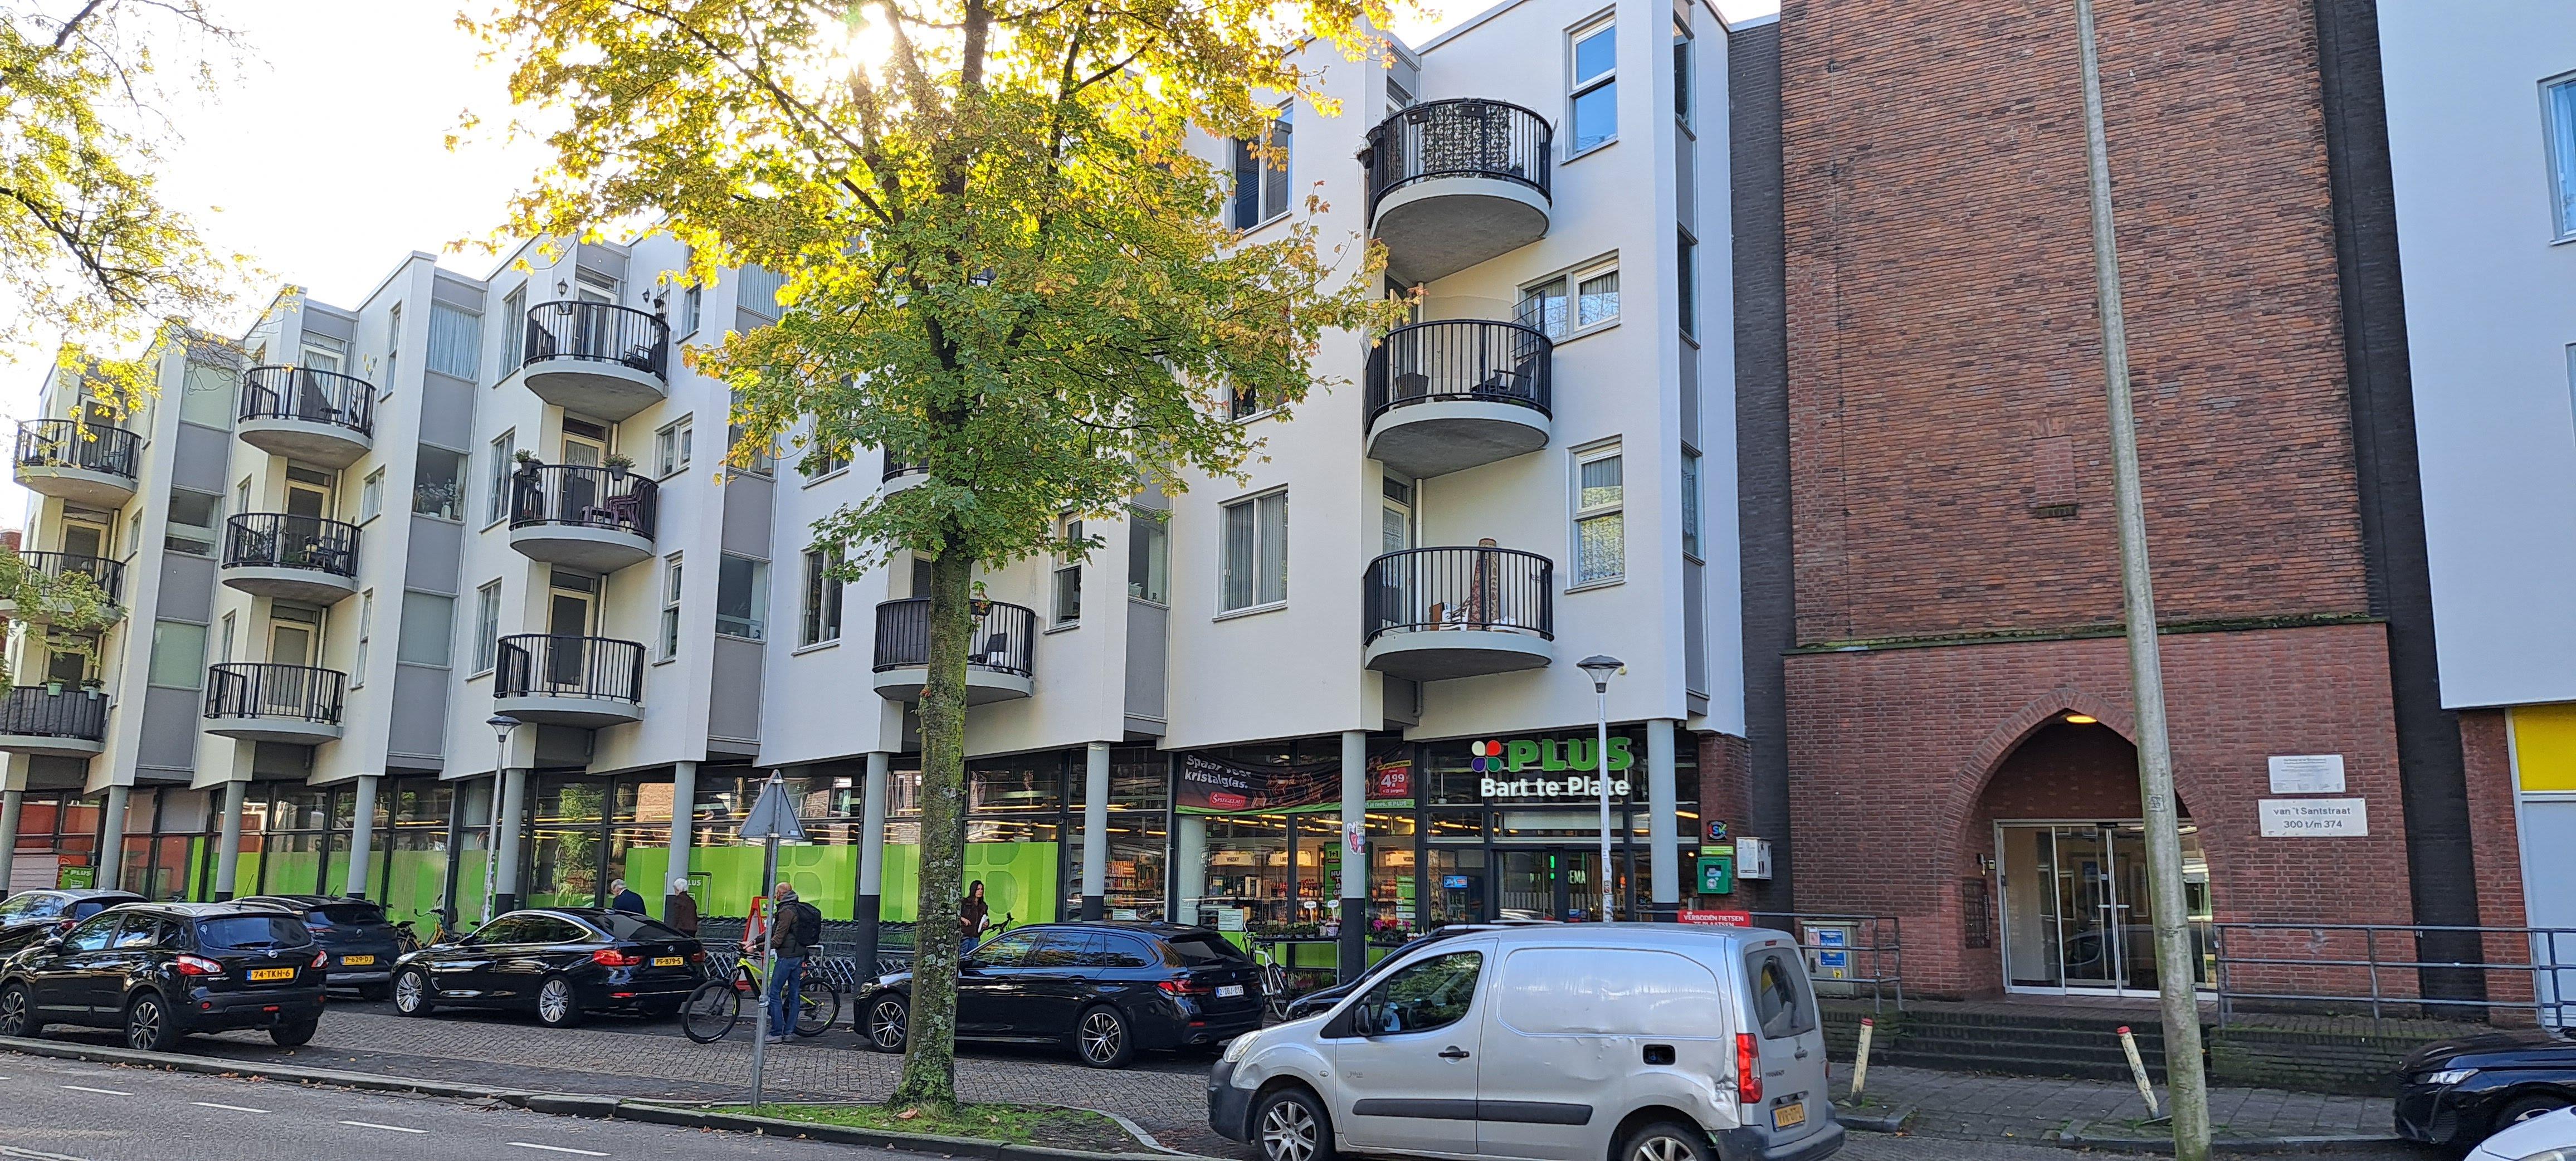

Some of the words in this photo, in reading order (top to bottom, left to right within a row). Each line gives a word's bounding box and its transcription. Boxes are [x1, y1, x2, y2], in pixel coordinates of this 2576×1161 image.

[1186, 754, 1222, 771] Spaar
[1507, 736, 1634, 772] PLUS
[1184, 768, 1248, 789] kristalglas.
[1481, 778, 1528, 797] Bart
[1537, 778, 1560, 797] te
[1568, 775, 1631, 797] Plate
[253, 970, 290, 979] 74-TKH-6
